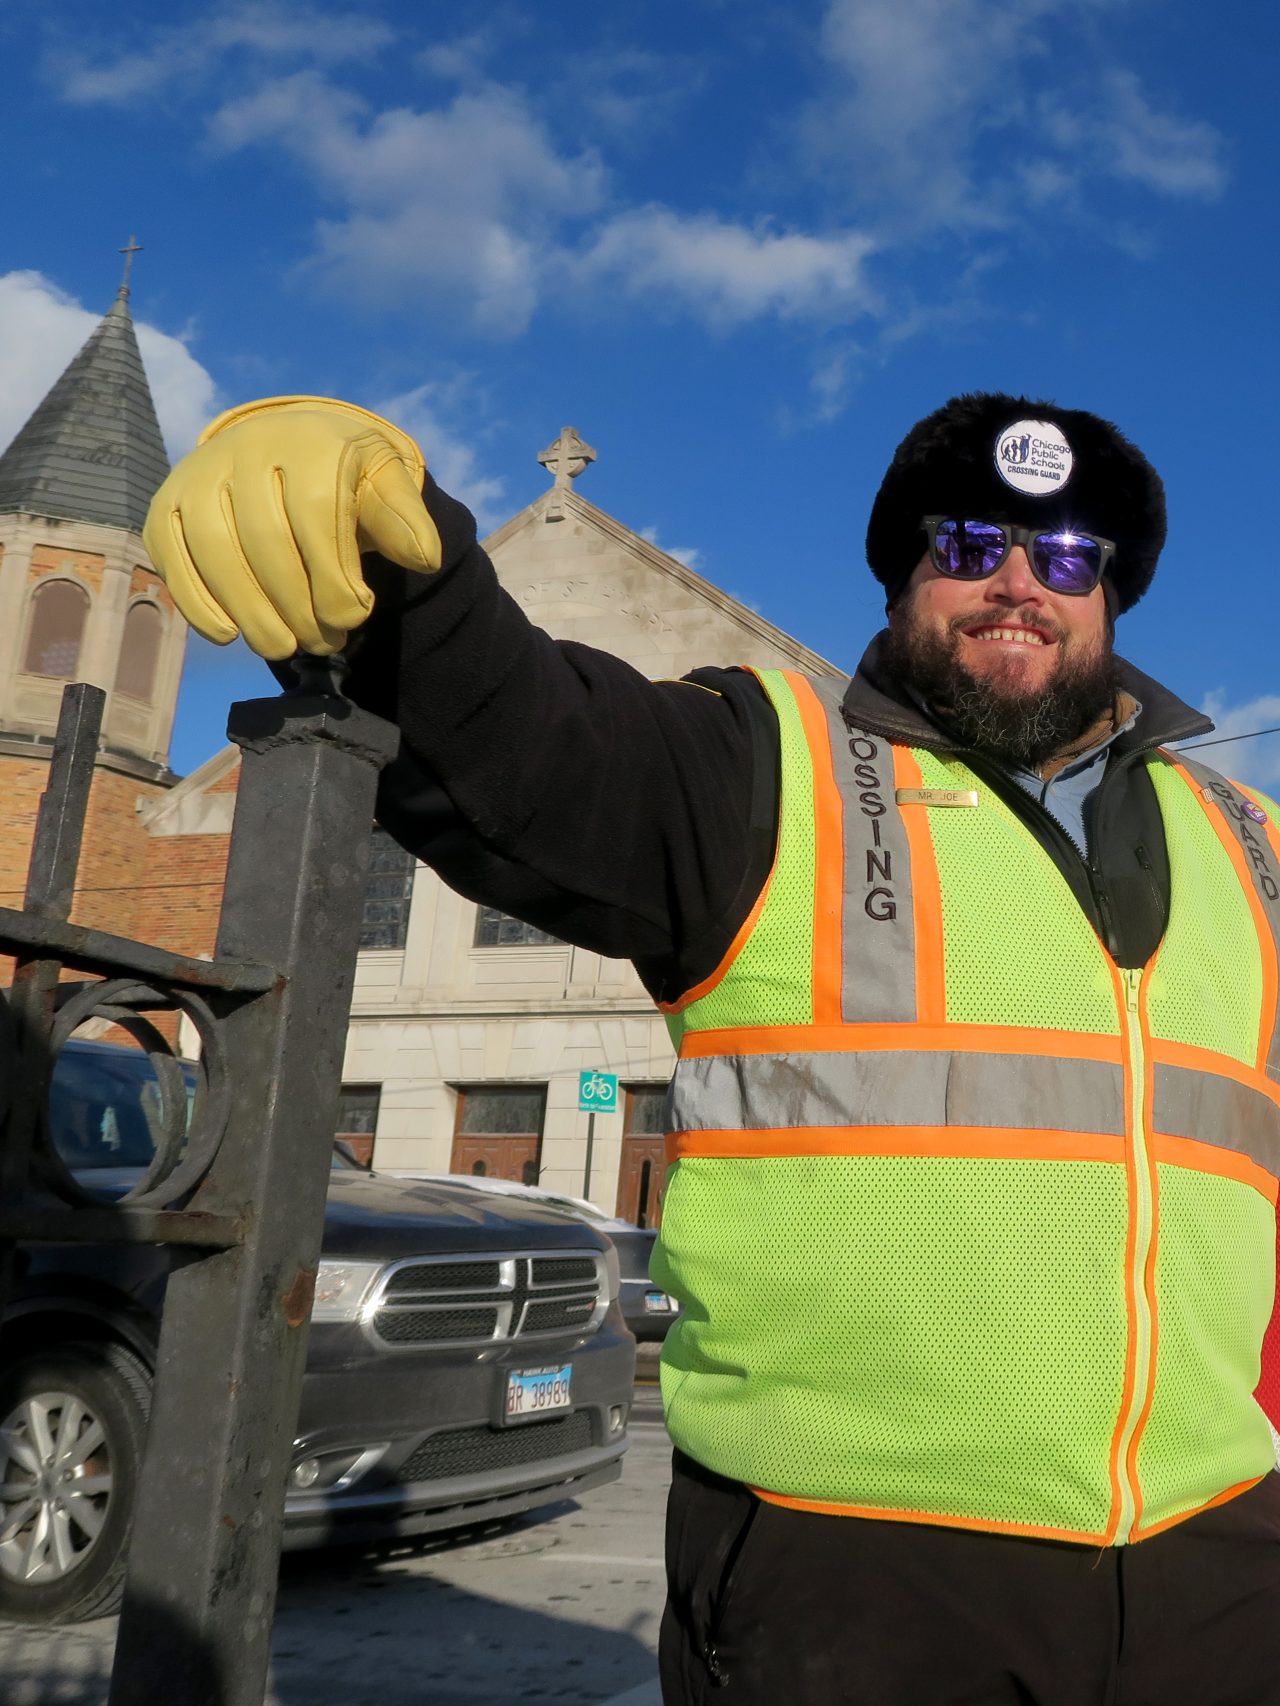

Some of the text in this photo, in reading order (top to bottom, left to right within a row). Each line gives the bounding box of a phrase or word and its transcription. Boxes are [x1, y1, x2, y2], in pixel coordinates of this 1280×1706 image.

[1032, 438, 1071, 454] Chicago
[1032, 447, 1059, 461] Public
[1030, 457, 1065, 471] Schools
[1007, 464, 1061, 481] CROSSING GUARD
[942, 792, 959, 802] JOE
[848, 725, 897, 921] OSSING
[1208, 781, 1280, 901] GUARD
[531, 1379, 569, 1409] 38989
